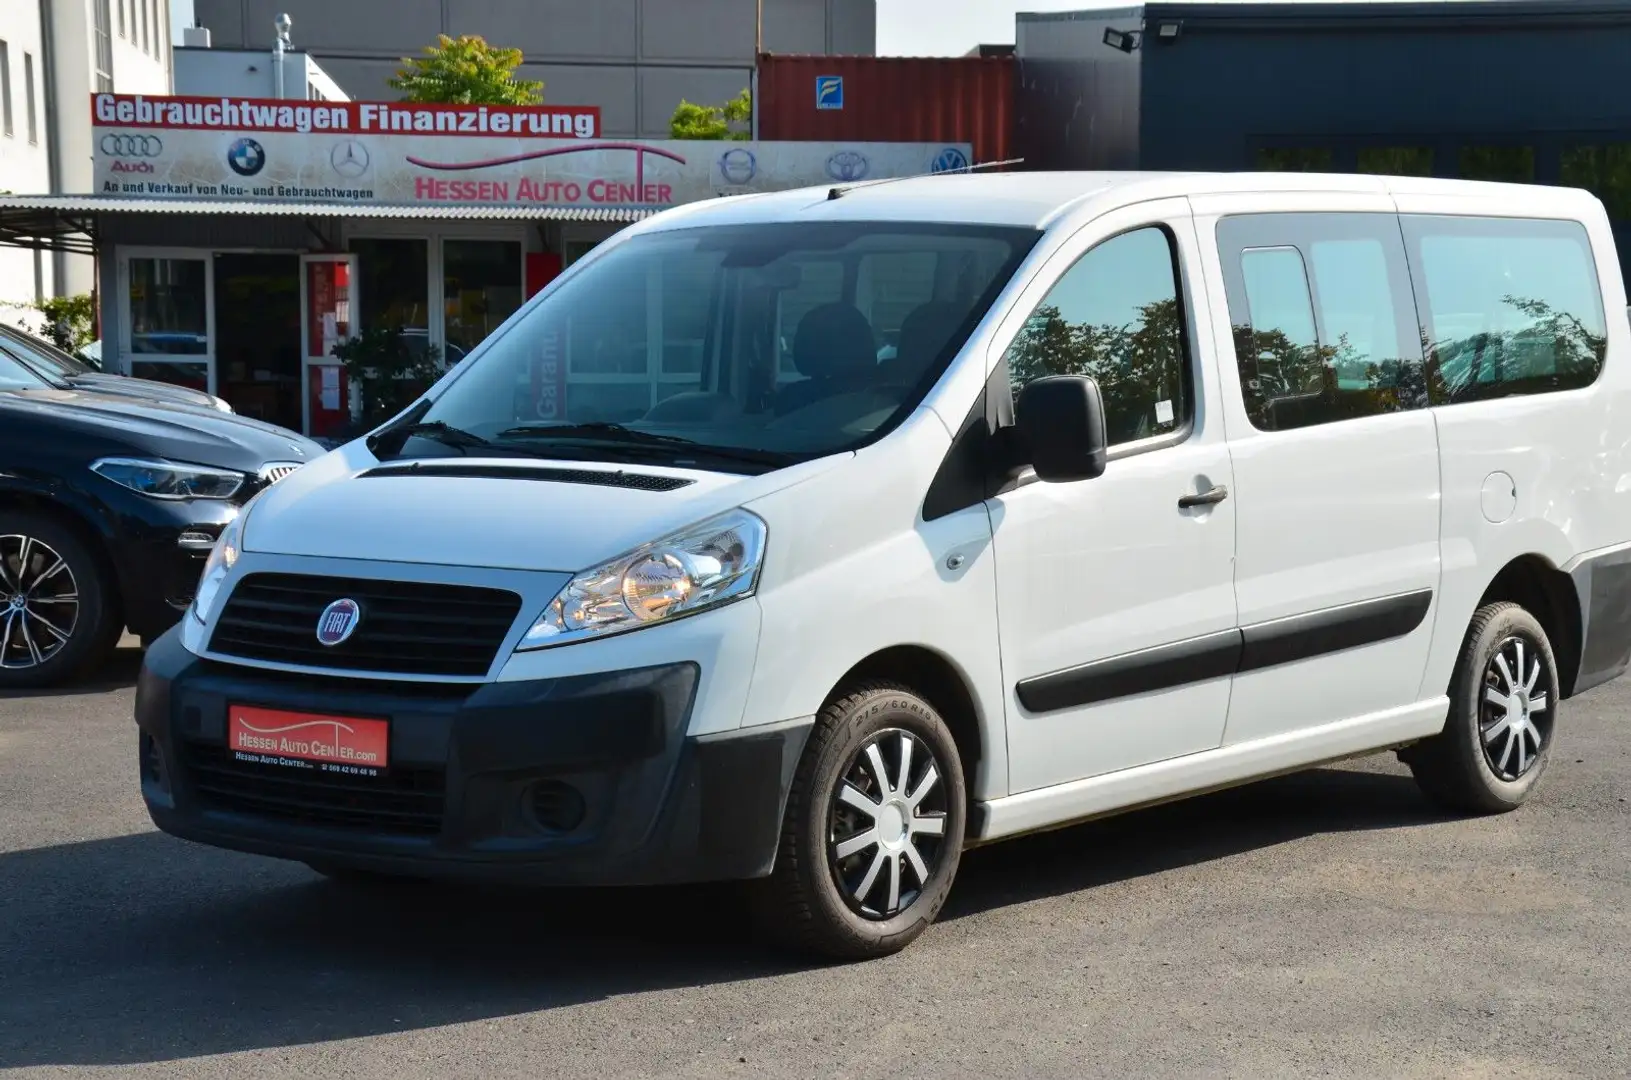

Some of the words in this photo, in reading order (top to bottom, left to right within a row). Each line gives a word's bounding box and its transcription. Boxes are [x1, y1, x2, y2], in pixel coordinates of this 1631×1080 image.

[95, 93, 348, 133] Gebrauchtwagen
[359, 103, 595, 138] Finanzierung
[110, 160, 155, 174] Audi
[103, 181, 119, 192] An
[123, 182, 144, 193] und
[148, 183, 193, 194] Verkauf
[197, 186, 218, 195] von
[221, 184, 250, 196] Neu-
[253, 186, 274, 196] und
[278, 186, 374, 200] Gebrauchtwagen
[415, 177, 508, 201] HESSEN
[515, 178, 582, 202] AUTO
[587, 178, 673, 203] CENTER
[324, 611, 351, 634] FIAT
[235, 751, 259, 762] HESSEN
[260, 755, 278, 765] AUTO
[238, 732, 278, 751] HESSEN
[280, 737, 309, 754] AUTO
[311, 740, 377, 762] CENTER.com
